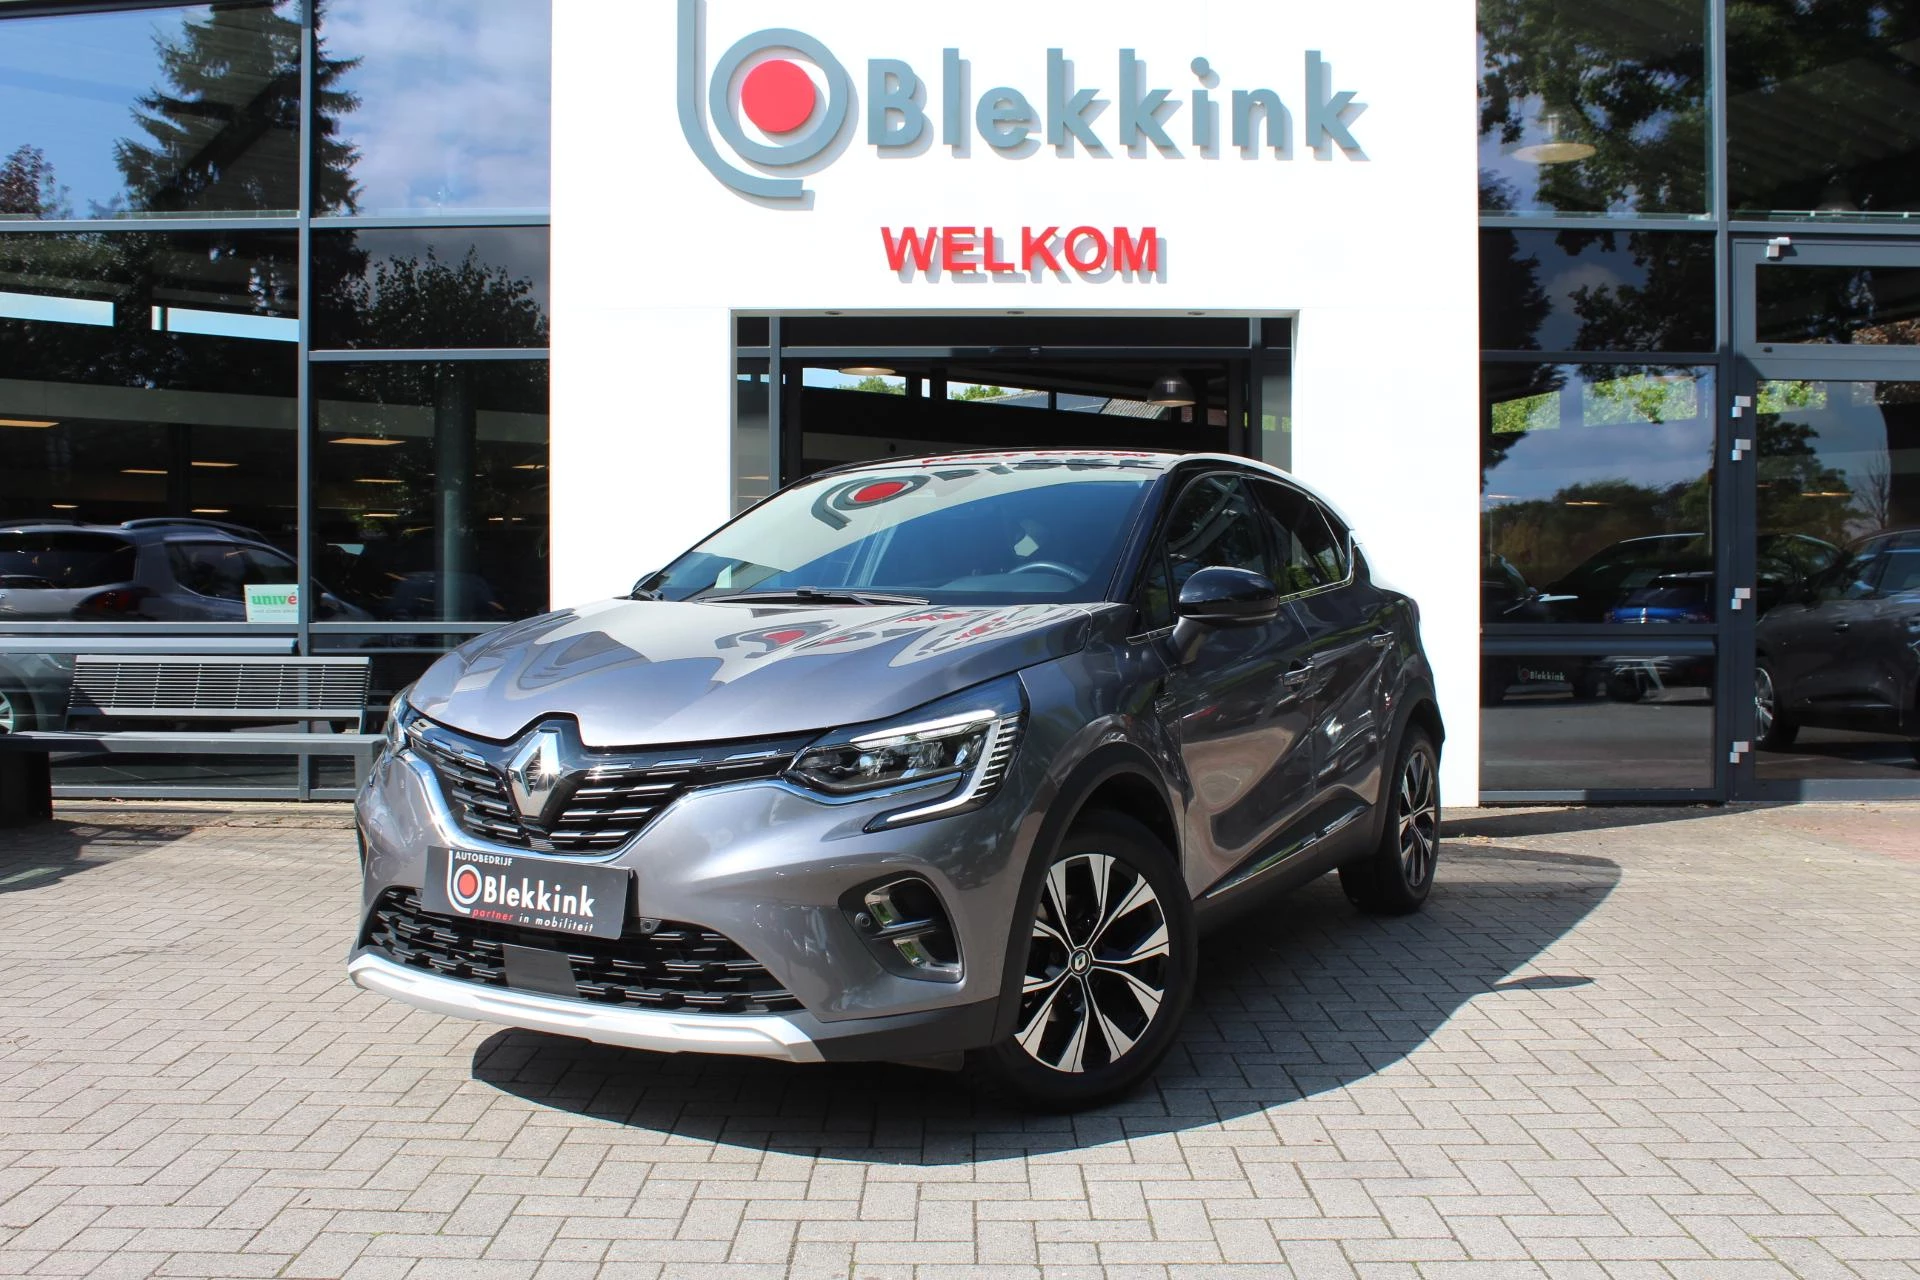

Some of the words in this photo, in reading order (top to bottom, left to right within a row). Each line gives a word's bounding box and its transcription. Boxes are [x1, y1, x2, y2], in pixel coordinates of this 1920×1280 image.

[867, 47, 1361, 150] Blekkink
[881, 226, 1158, 272] WELKOM
[252, 592, 297, 605] univé
[455, 851, 513, 867] AUTOBEDRIJF
[484, 875, 596, 917] Blekkink
[472, 908, 514, 921] partner
[519, 912, 529, 924] in
[535, 915, 594, 933] mobiliteit
